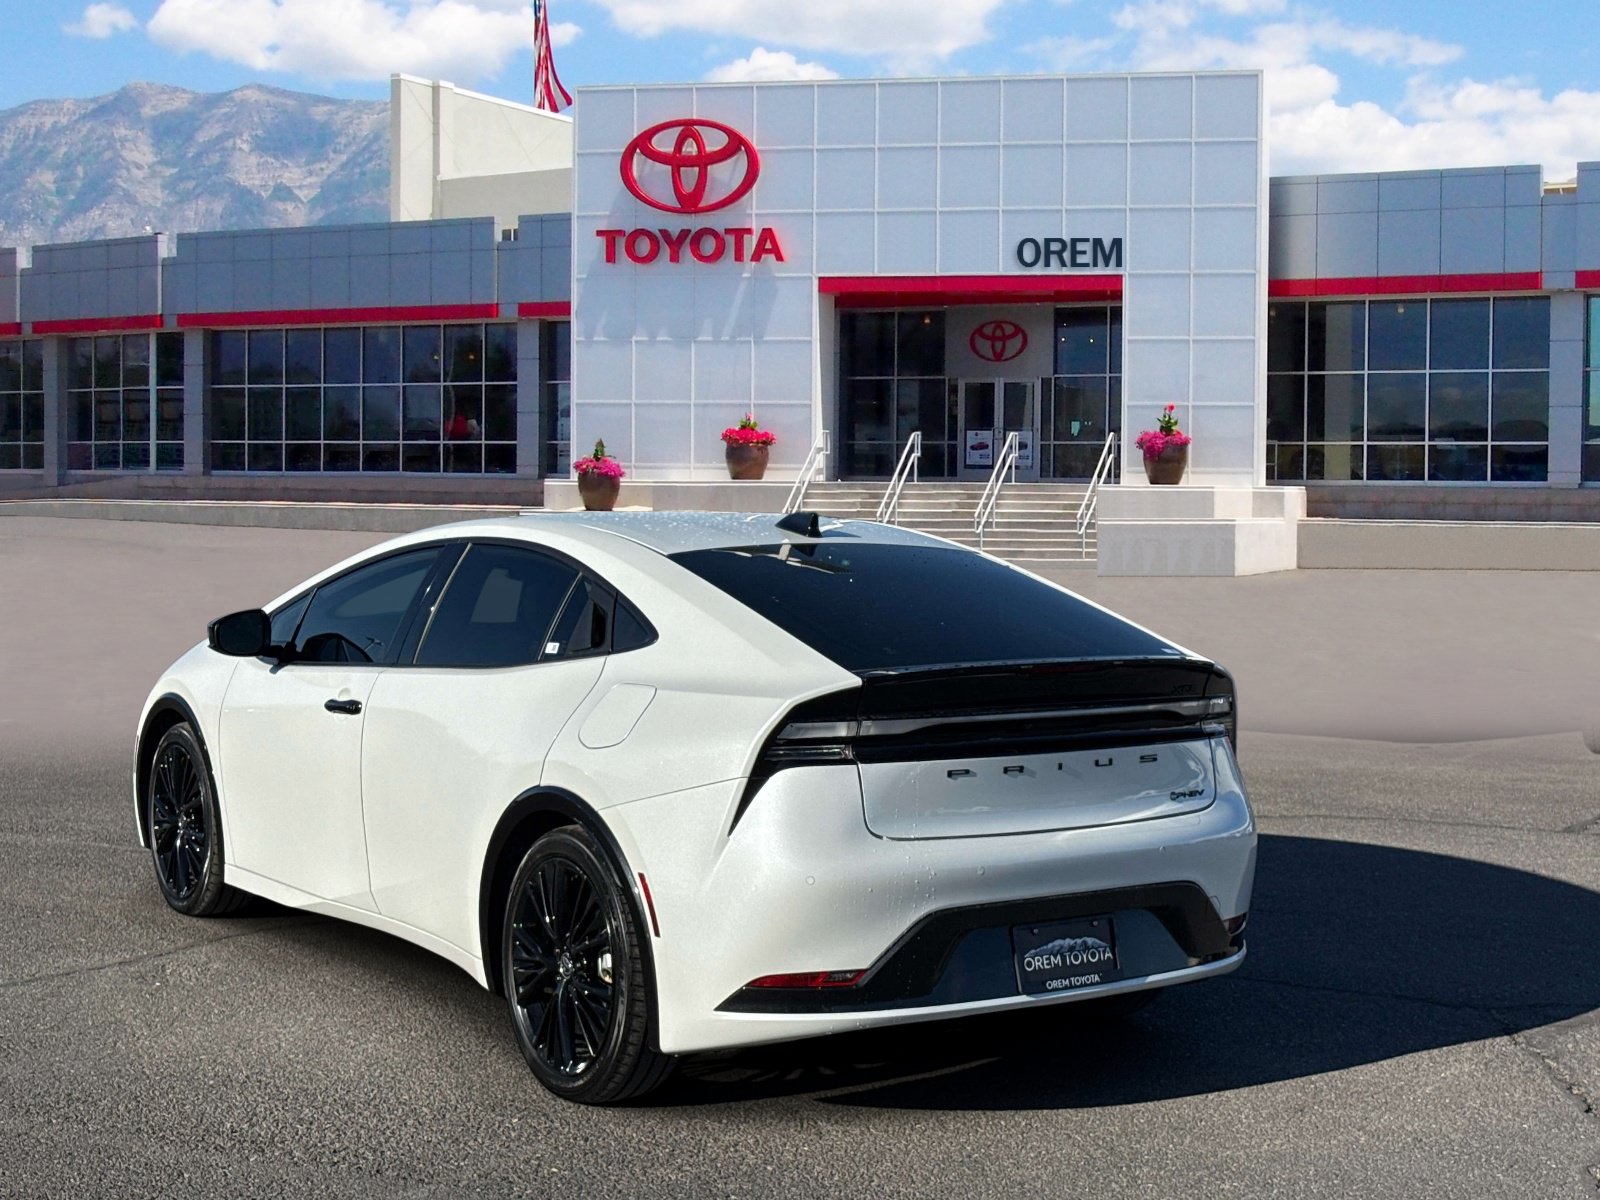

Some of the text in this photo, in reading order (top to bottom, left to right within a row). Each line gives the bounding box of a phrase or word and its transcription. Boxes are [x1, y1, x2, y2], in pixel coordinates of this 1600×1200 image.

[596, 227, 784, 264] TOYOTA
[1017, 237, 1123, 268] OREM
[947, 754, 1158, 778] PRIUS
[1024, 947, 1113, 972] OREM TOYOTA
[1045, 973, 1100, 990] OREM TOYOTA
